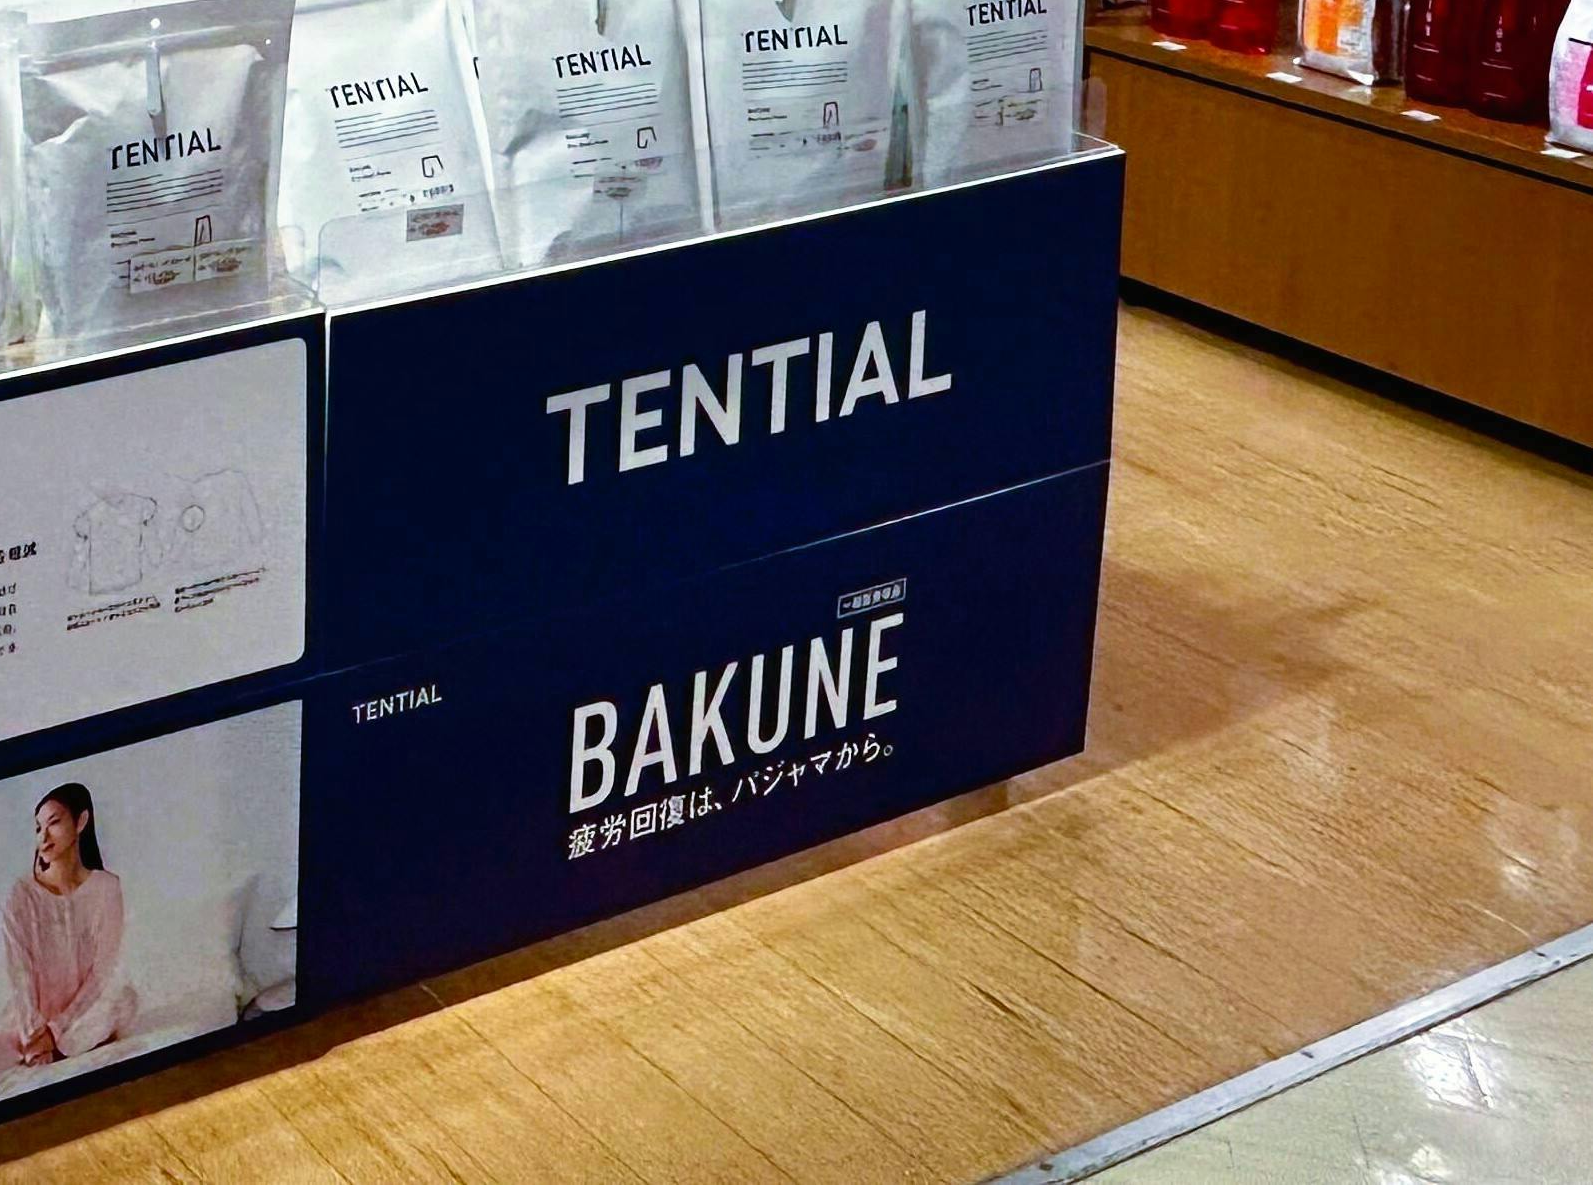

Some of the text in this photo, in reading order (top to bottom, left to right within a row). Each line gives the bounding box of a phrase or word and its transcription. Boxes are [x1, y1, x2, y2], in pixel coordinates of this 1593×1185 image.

[743, 23, 849, 53] TENTIAL
[552, 43, 652, 79] TENTIAL
[327, 71, 429, 110] TENTIAL
[111, 127, 222, 171] TENTIAL
[546, 309, 953, 486] TENTIAL
[352, 683, 443, 725] TENTIAL
[568, 612, 905, 815] BAKUNE
[567, 732, 894, 861] 疲労回復は、パジャマから。
